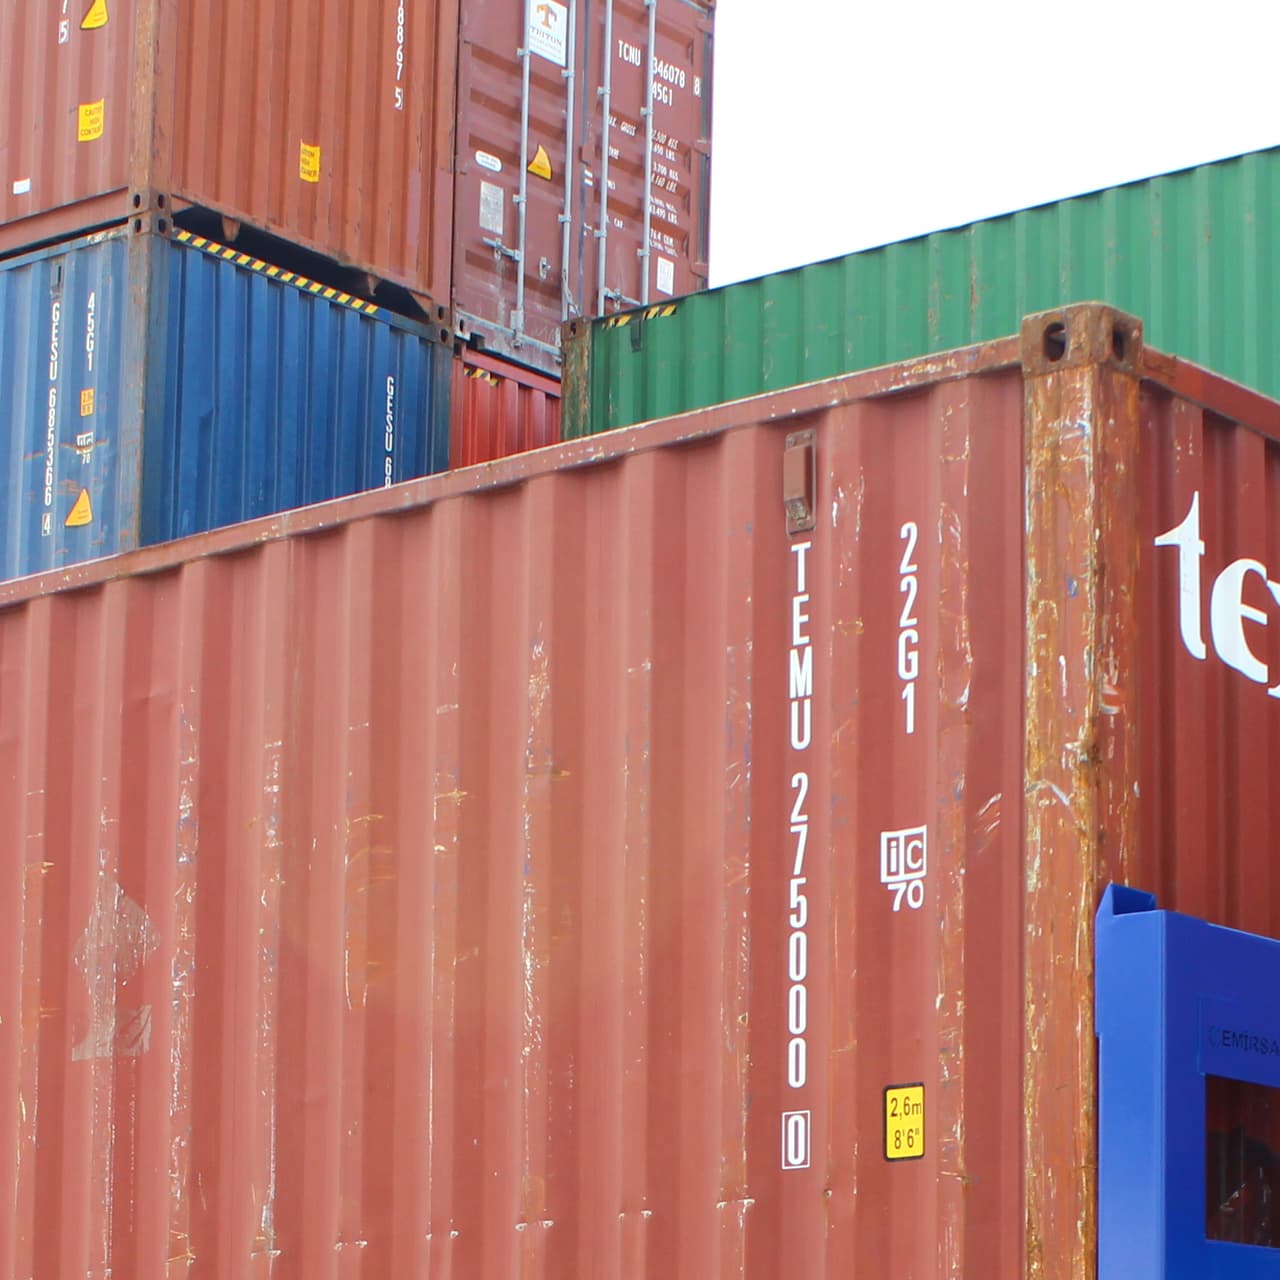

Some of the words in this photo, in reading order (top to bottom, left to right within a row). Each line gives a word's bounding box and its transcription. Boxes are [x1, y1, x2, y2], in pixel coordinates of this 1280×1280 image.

[58, 20, 69, 44] 5
[618, 40, 641, 67] TCNU
[652, 56, 686, 89] 346078
[693, 75, 702, 98] 8
[652, 81, 673, 106] 45G1
[394, 87, 404, 111] 5
[49, 301, 60, 381] GESU
[86, 292, 96, 372] 45G1
[385, 376, 394, 452] GESU
[44, 387, 57, 506] 685366
[41, 512, 52, 537] 4
[789, 541, 813, 750] TEMU
[898, 521, 919, 734] 22G1
[887, 880, 925, 912] 70
[788, 771, 809, 1089] 275000
[890, 1096, 923, 1119] 2,6m
[785, 1112, 808, 1168] 0
